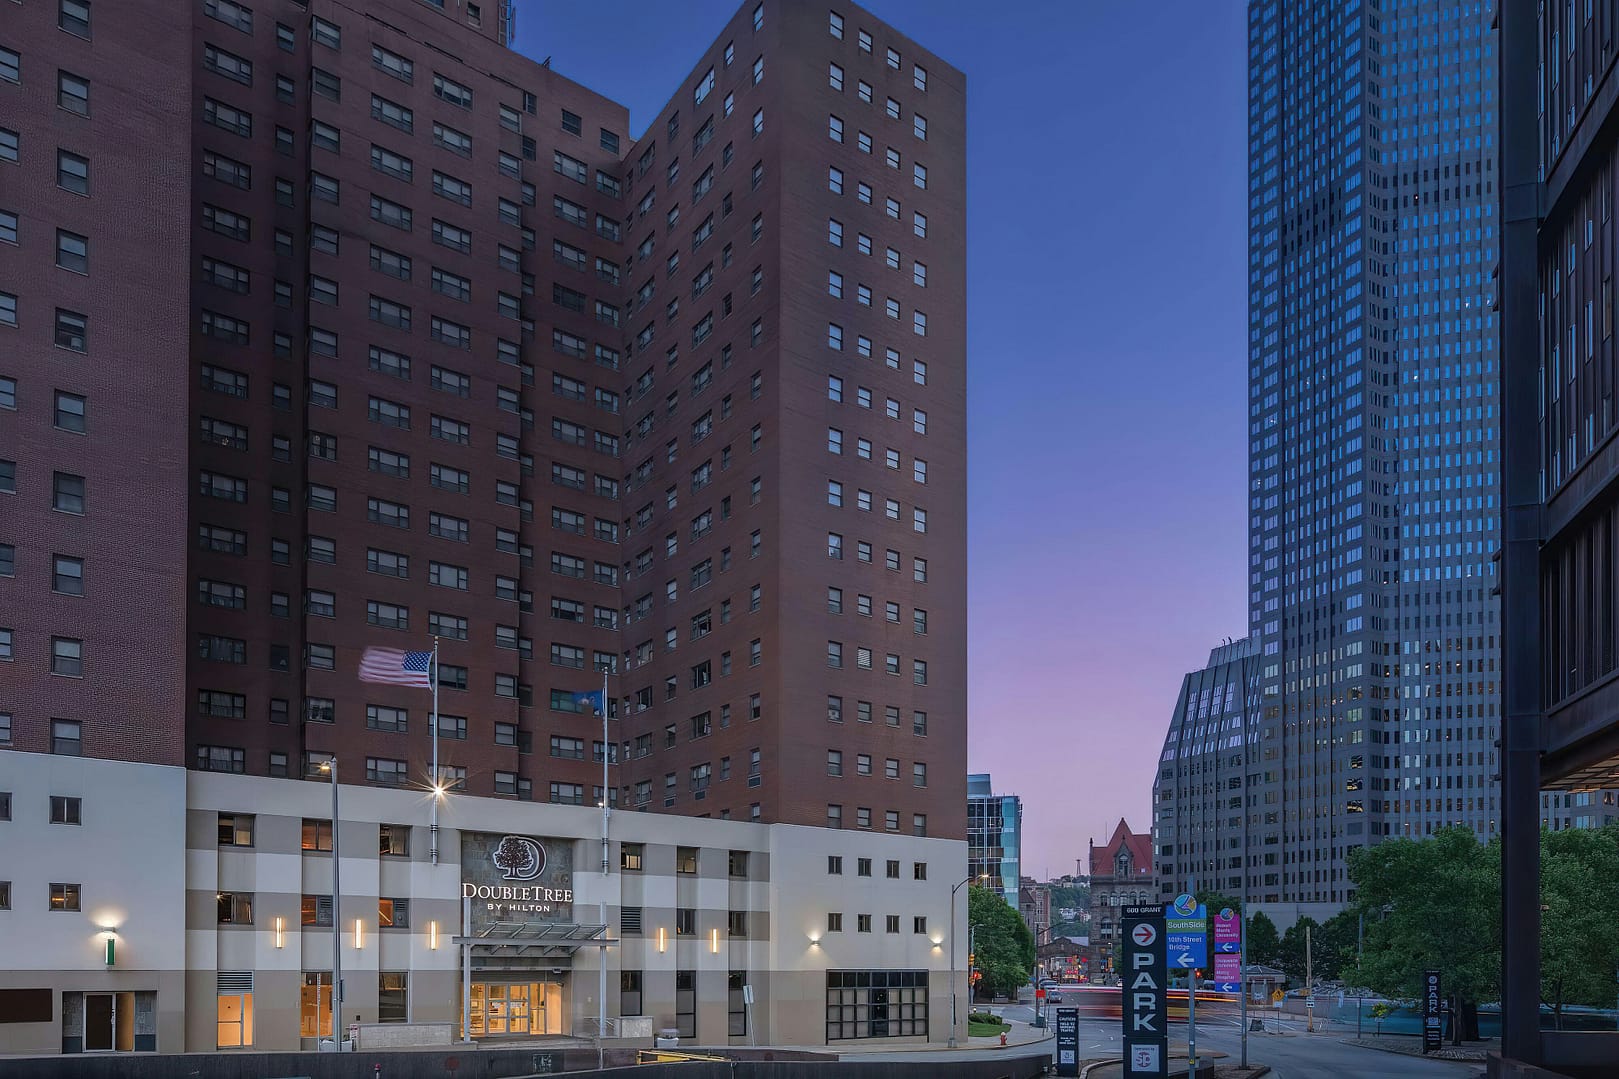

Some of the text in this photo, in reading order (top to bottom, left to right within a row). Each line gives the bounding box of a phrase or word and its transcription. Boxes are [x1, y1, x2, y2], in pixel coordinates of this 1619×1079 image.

[487, 903, 550, 912] BY HILTON
[1131, 952, 1158, 1031] PARK
[1428, 985, 1438, 1013] PARK
